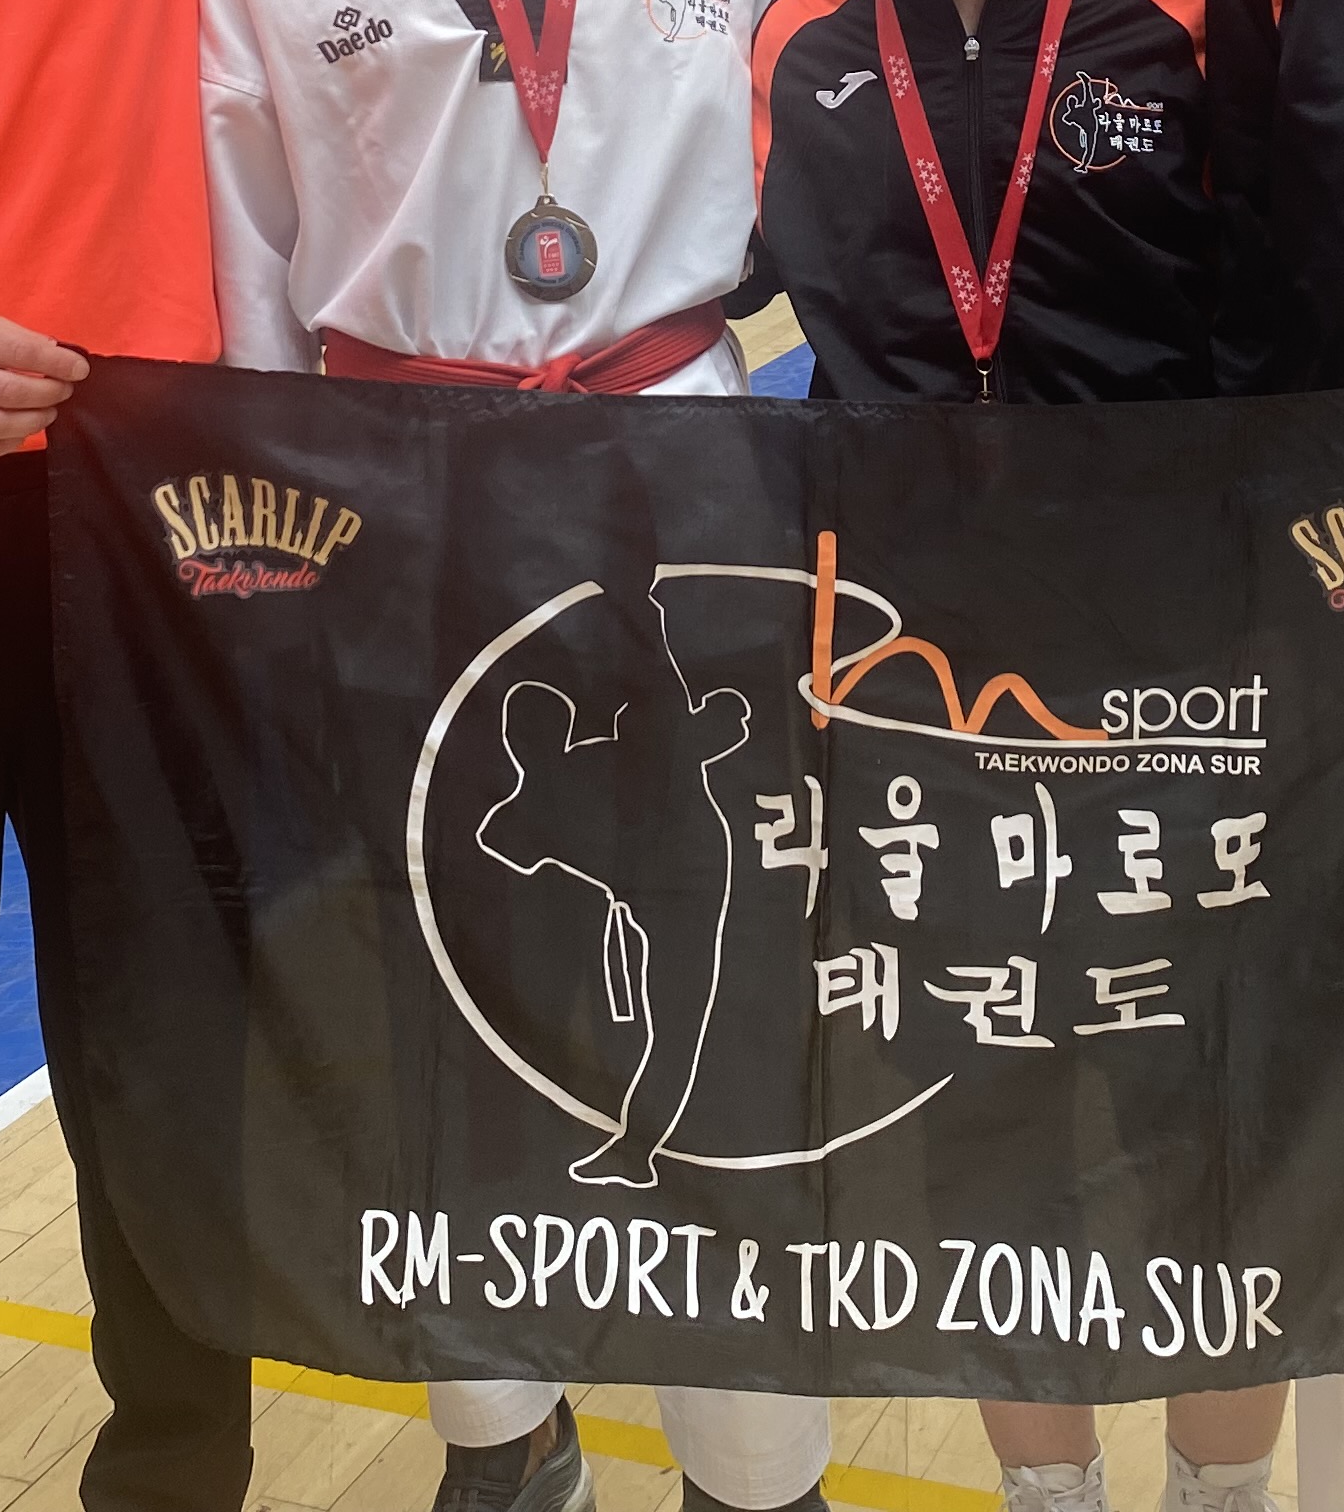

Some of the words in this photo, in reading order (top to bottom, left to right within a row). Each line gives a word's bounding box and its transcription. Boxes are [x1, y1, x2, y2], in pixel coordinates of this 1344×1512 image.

[317, 17, 393, 64] Daedo
[154, 474, 363, 566] SCARLIP
[1101, 674, 1268, 740] sport
[974, 751, 1130, 774] TAEKWONDO
[1136, 753, 1205, 775] ZONA
[1210, 754, 1261, 776] SUR
[812, 941, 1186, 1048] 태권도
[360, 1208, 717, 1319] RM-SPORT
[731, 1238, 770, 1323] &
[785, 1240, 919, 1333] TKD
[936, 1238, 1125, 1351] ZONA
[1142, 1257, 1283, 1357] SUR
